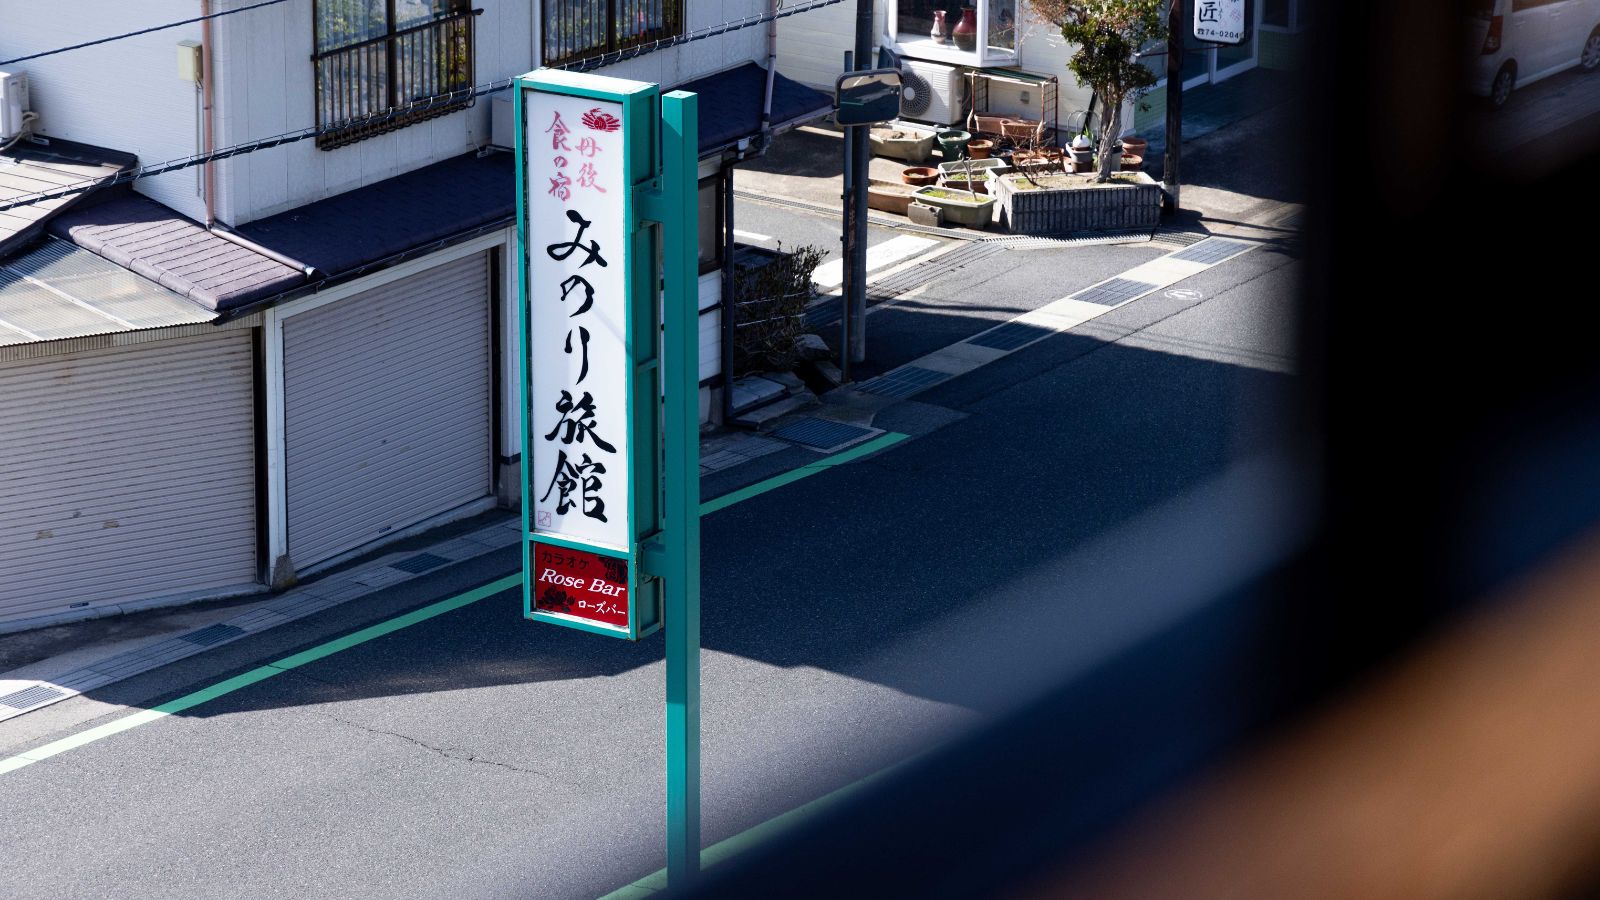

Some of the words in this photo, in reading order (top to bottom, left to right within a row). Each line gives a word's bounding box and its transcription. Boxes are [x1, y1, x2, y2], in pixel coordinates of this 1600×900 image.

[1199, 2, 1218, 22] 匠
[545, 111, 572, 201] 食の宿
[575, 137, 607, 193] 丹後
[540, 210, 617, 523] みのり旅館
[542, 551, 590, 570] カラオケ
[539, 568, 585, 589] Rose
[588, 578, 626, 597] Bar
[578, 600, 626, 615] ローズバー
